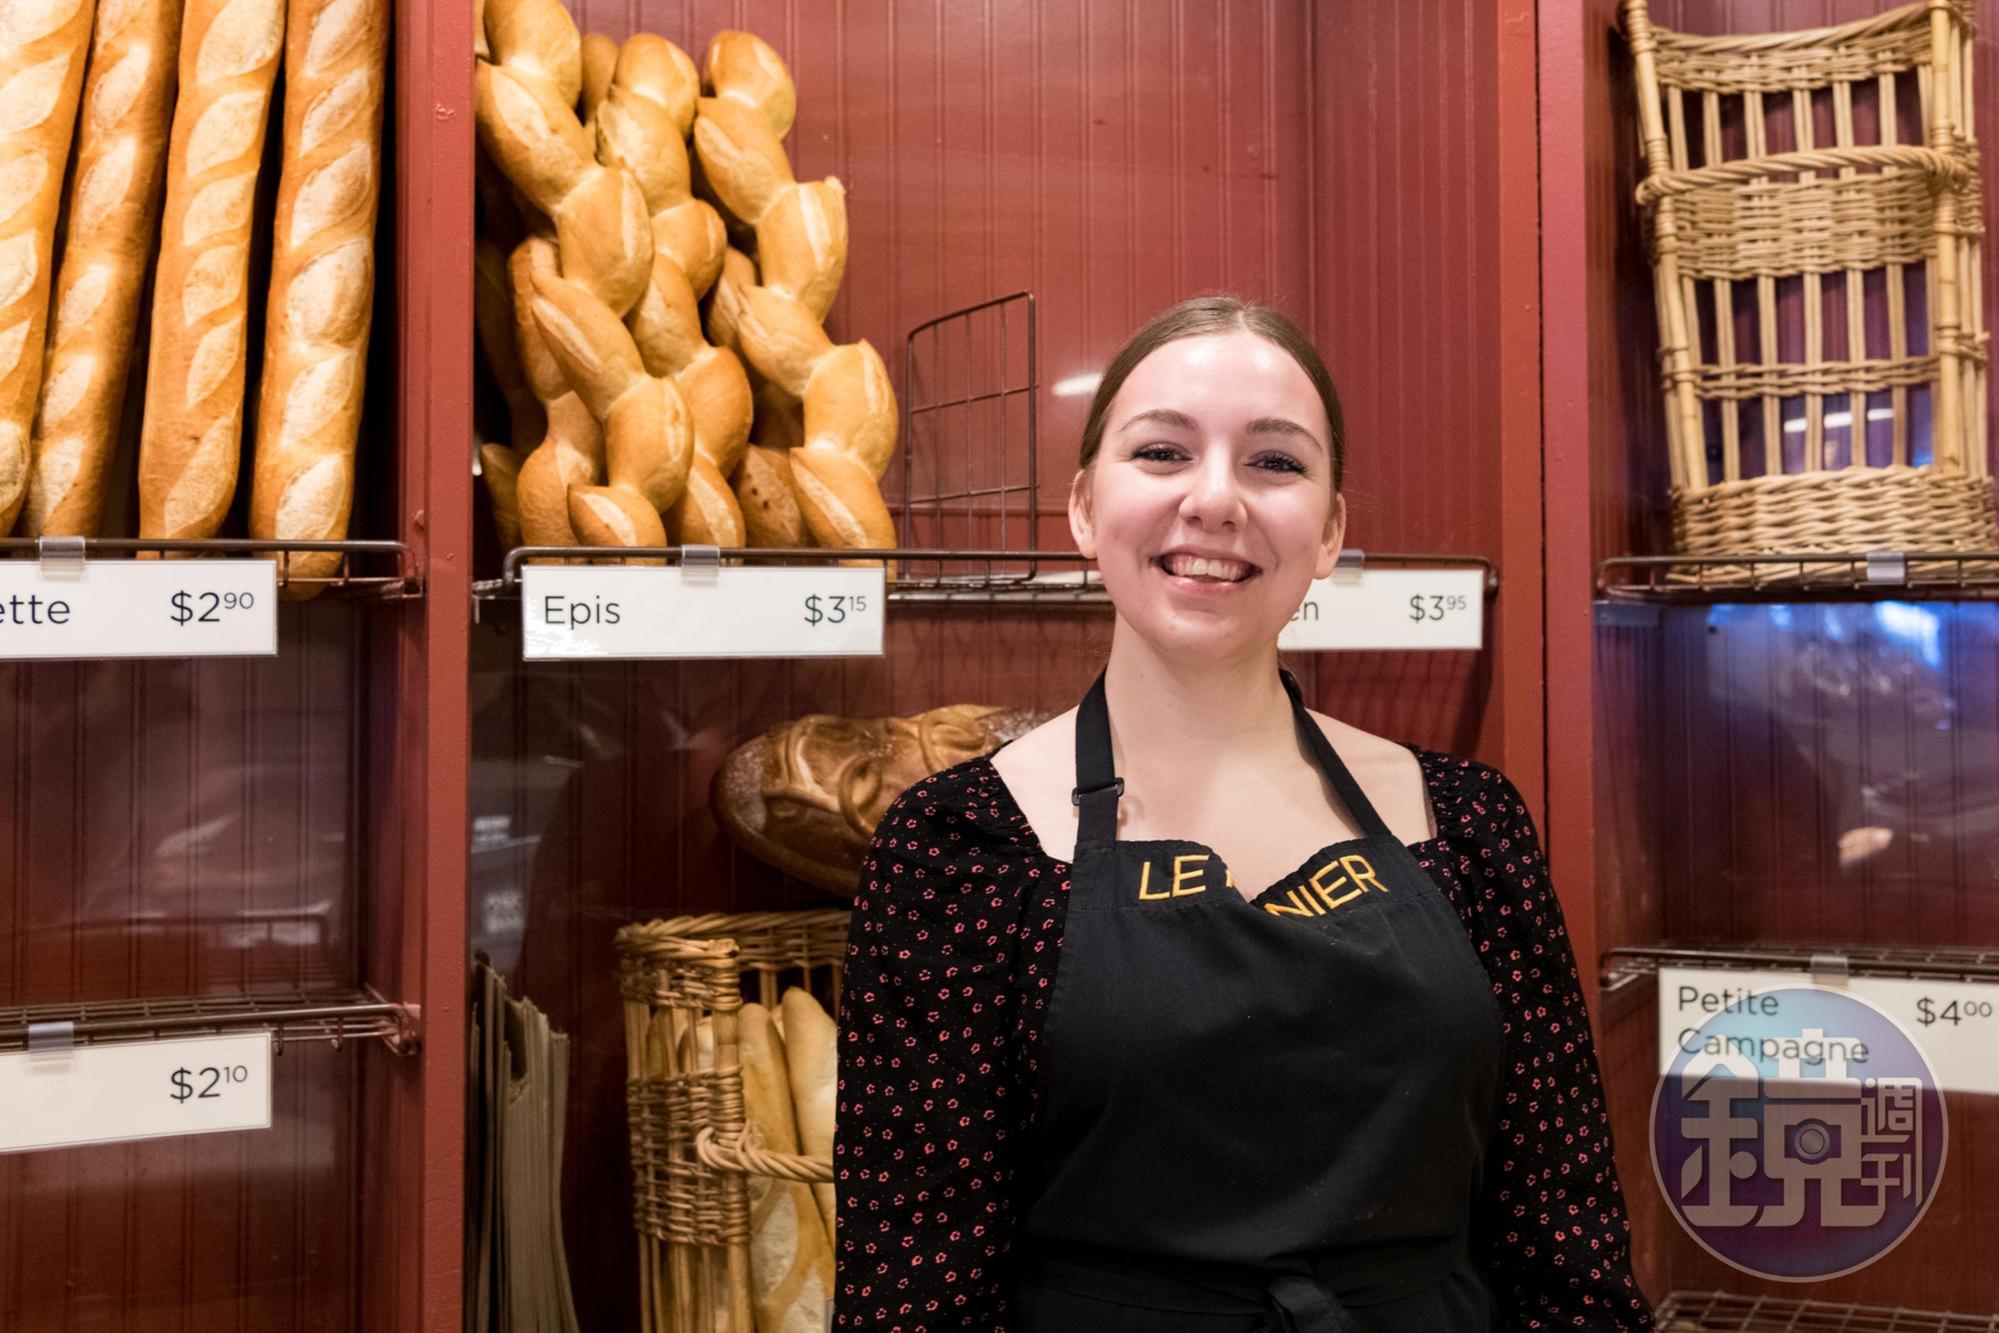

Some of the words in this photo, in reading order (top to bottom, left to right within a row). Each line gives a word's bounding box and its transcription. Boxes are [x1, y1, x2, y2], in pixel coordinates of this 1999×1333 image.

[0, 595, 71, 625] tte
[544, 595, 621, 630] Epis
[1139, 854, 1209, 900] LE
[1678, 986, 1780, 1016] Petite
[1678, 1027, 1870, 1066] Campagne
